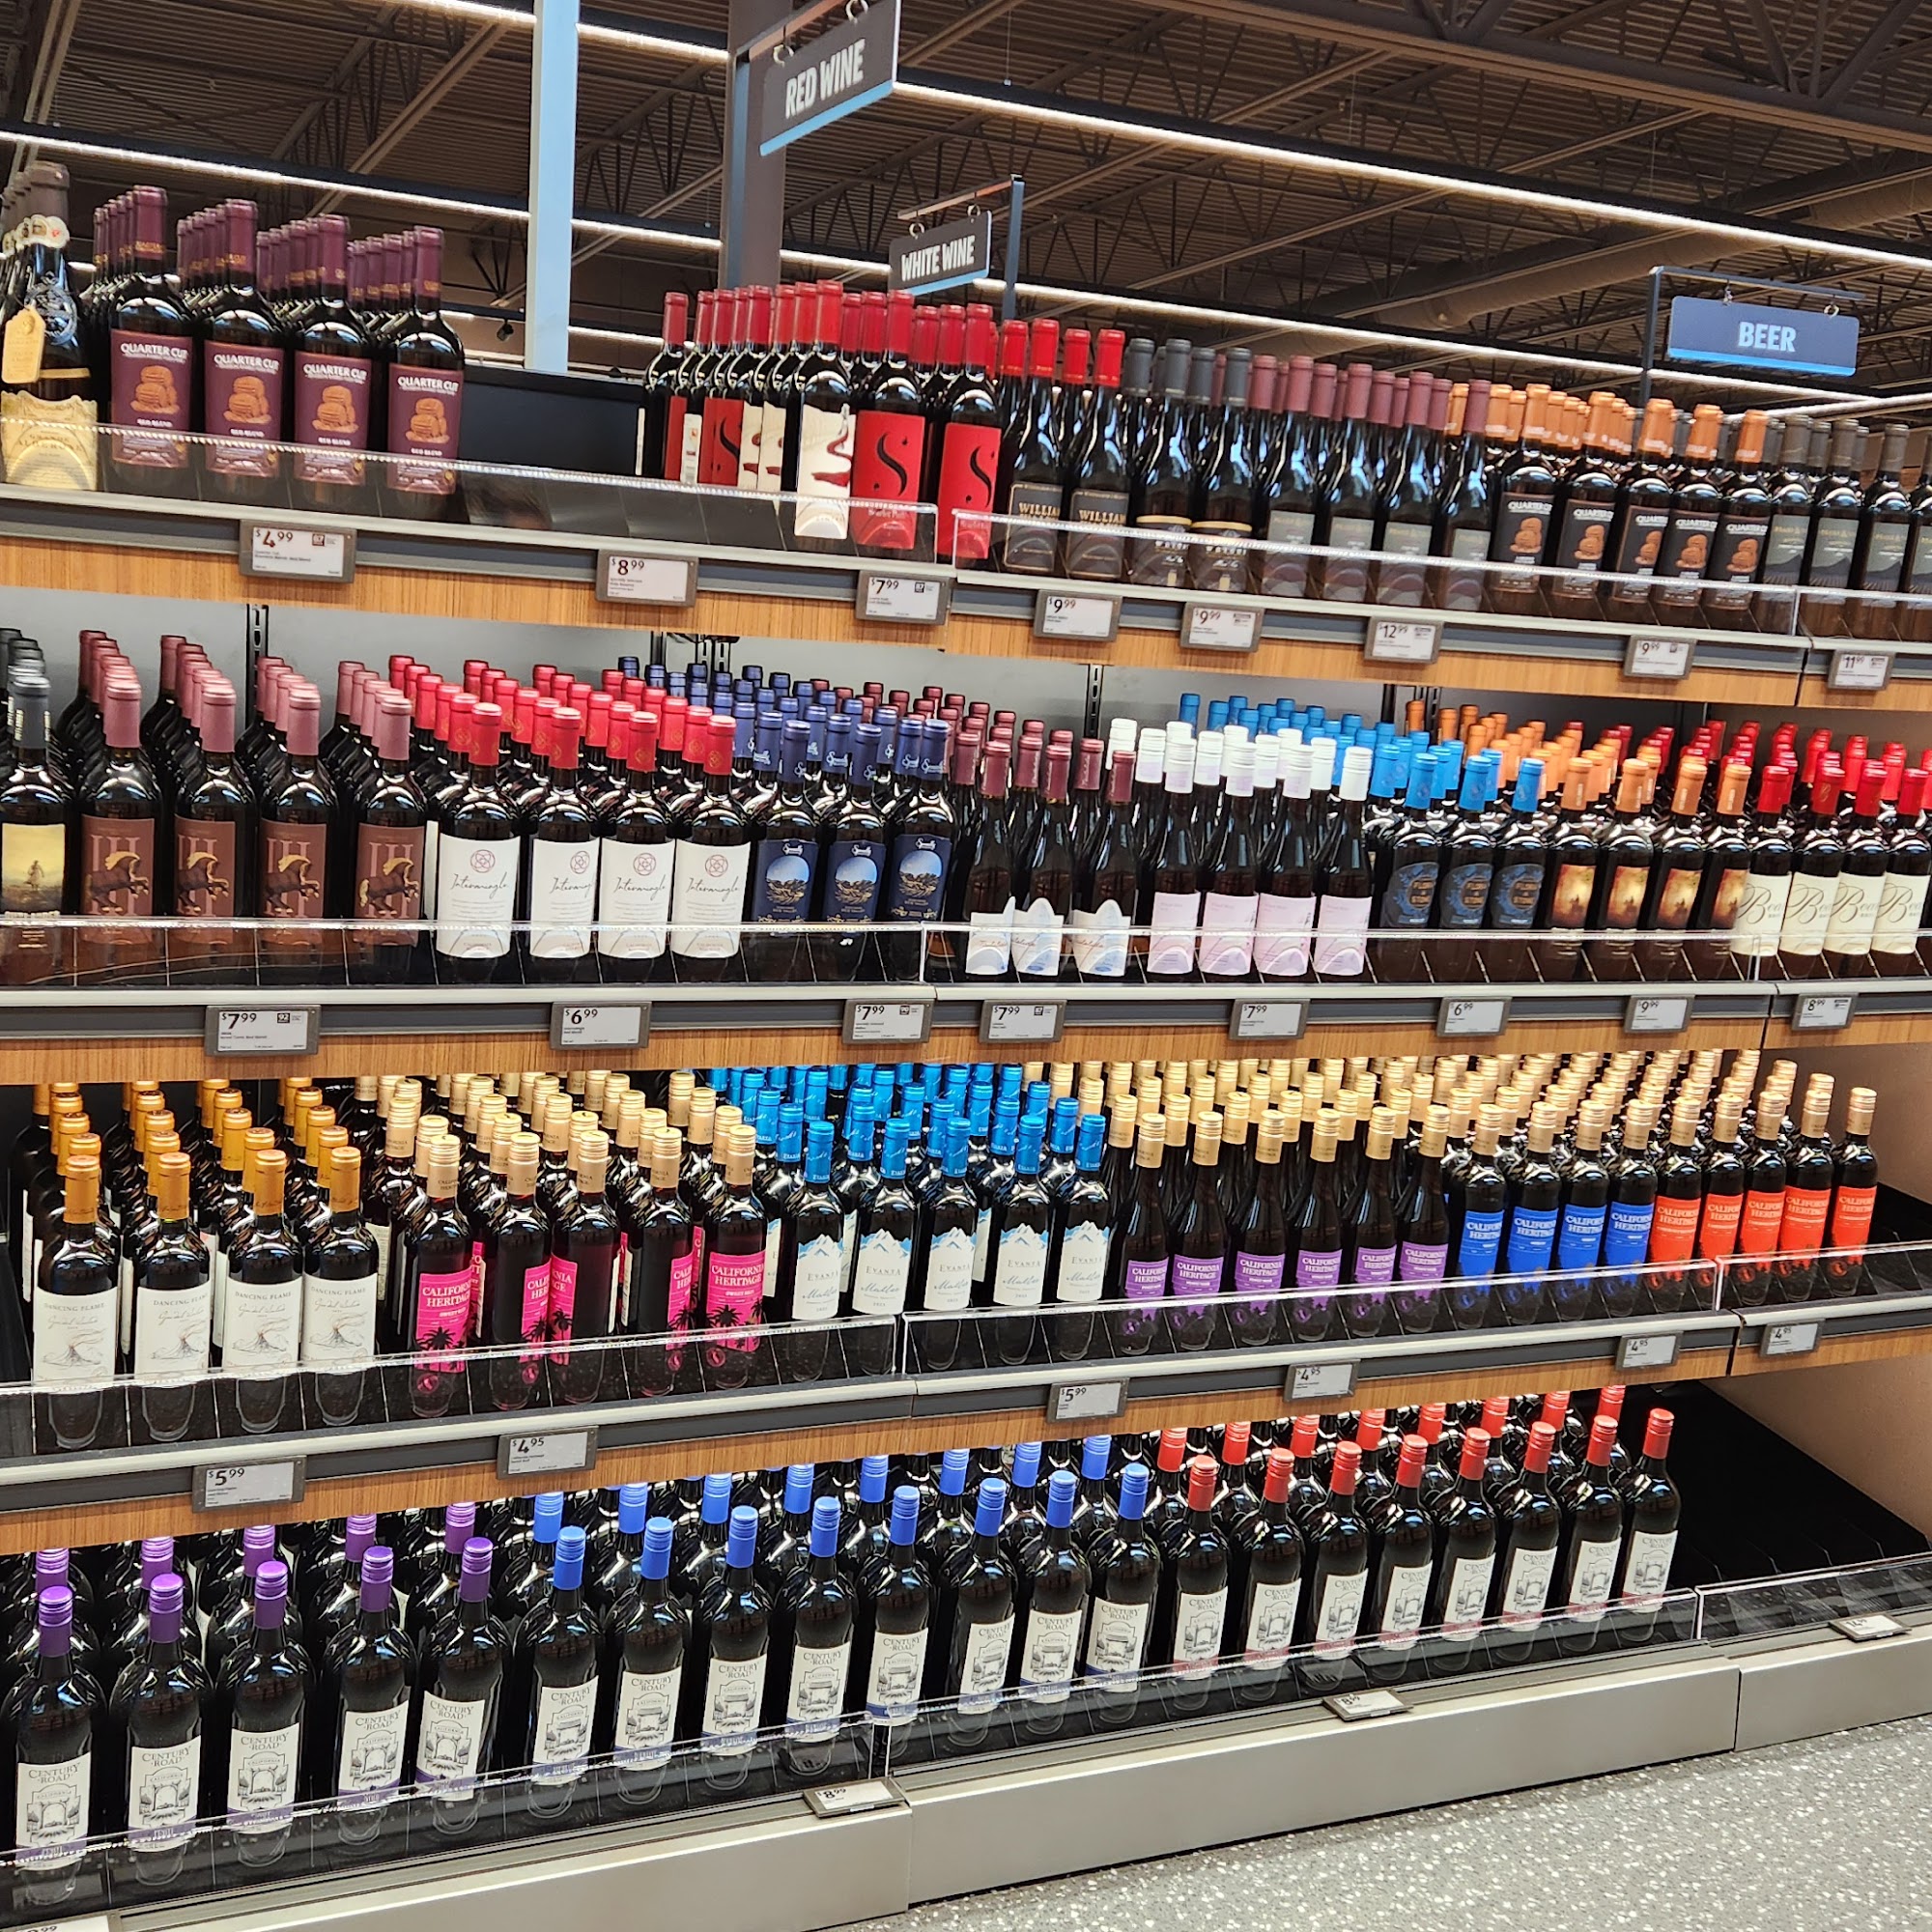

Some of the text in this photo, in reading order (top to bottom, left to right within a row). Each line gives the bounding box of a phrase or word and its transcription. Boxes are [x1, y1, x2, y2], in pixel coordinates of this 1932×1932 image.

[784, 38, 867, 120] RED WINE
[900, 235, 976, 282] WHITE WINE
[1737, 321, 1797, 353] BEER
[121, 342, 170, 358] QUARTER
[213, 354, 264, 368] QUARTER
[303, 363, 352, 378] QUARTER
[397, 376, 443, 389] QUARTER
[1179, 1269, 1217, 1279] HERITAGE
[714, 1274, 762, 1287] HERITAGE
[311, 1286, 366, 1295] DANCING FLAME
[422, 1279, 472, 1296] CALIFORN
[235, 1291, 292, 1300] DANCING FLAME
[1188, 1595, 1223, 1607] CENTURY
[1101, 1605, 1140, 1617] CENTURY
[1037, 1616, 1074, 1625] CENTURY
[883, 1635, 922, 1647] CENTURY
[803, 1650, 841, 1662] CENTURY
[719, 1662, 758, 1674] CENTURY
[631, 1675, 672, 1687] CENTURY
[551, 1685, 591, 1701] CENTURY
[430, 1699, 474, 1715] CENTURY
[355, 1710, 401, 1726] CENTURY
[439, 1711, 465, 1719] ROAD
[366, 1720, 392, 1731] ROAD
[242, 1732, 289, 1746] CENTURY
[252, 1743, 279, 1751] ROAD
[142, 1746, 191, 1763] CENTURY
[154, 1757, 182, 1768] ROAD
[28, 1762, 80, 1780] CENTURY
[41, 1774, 71, 1784] ROAD
